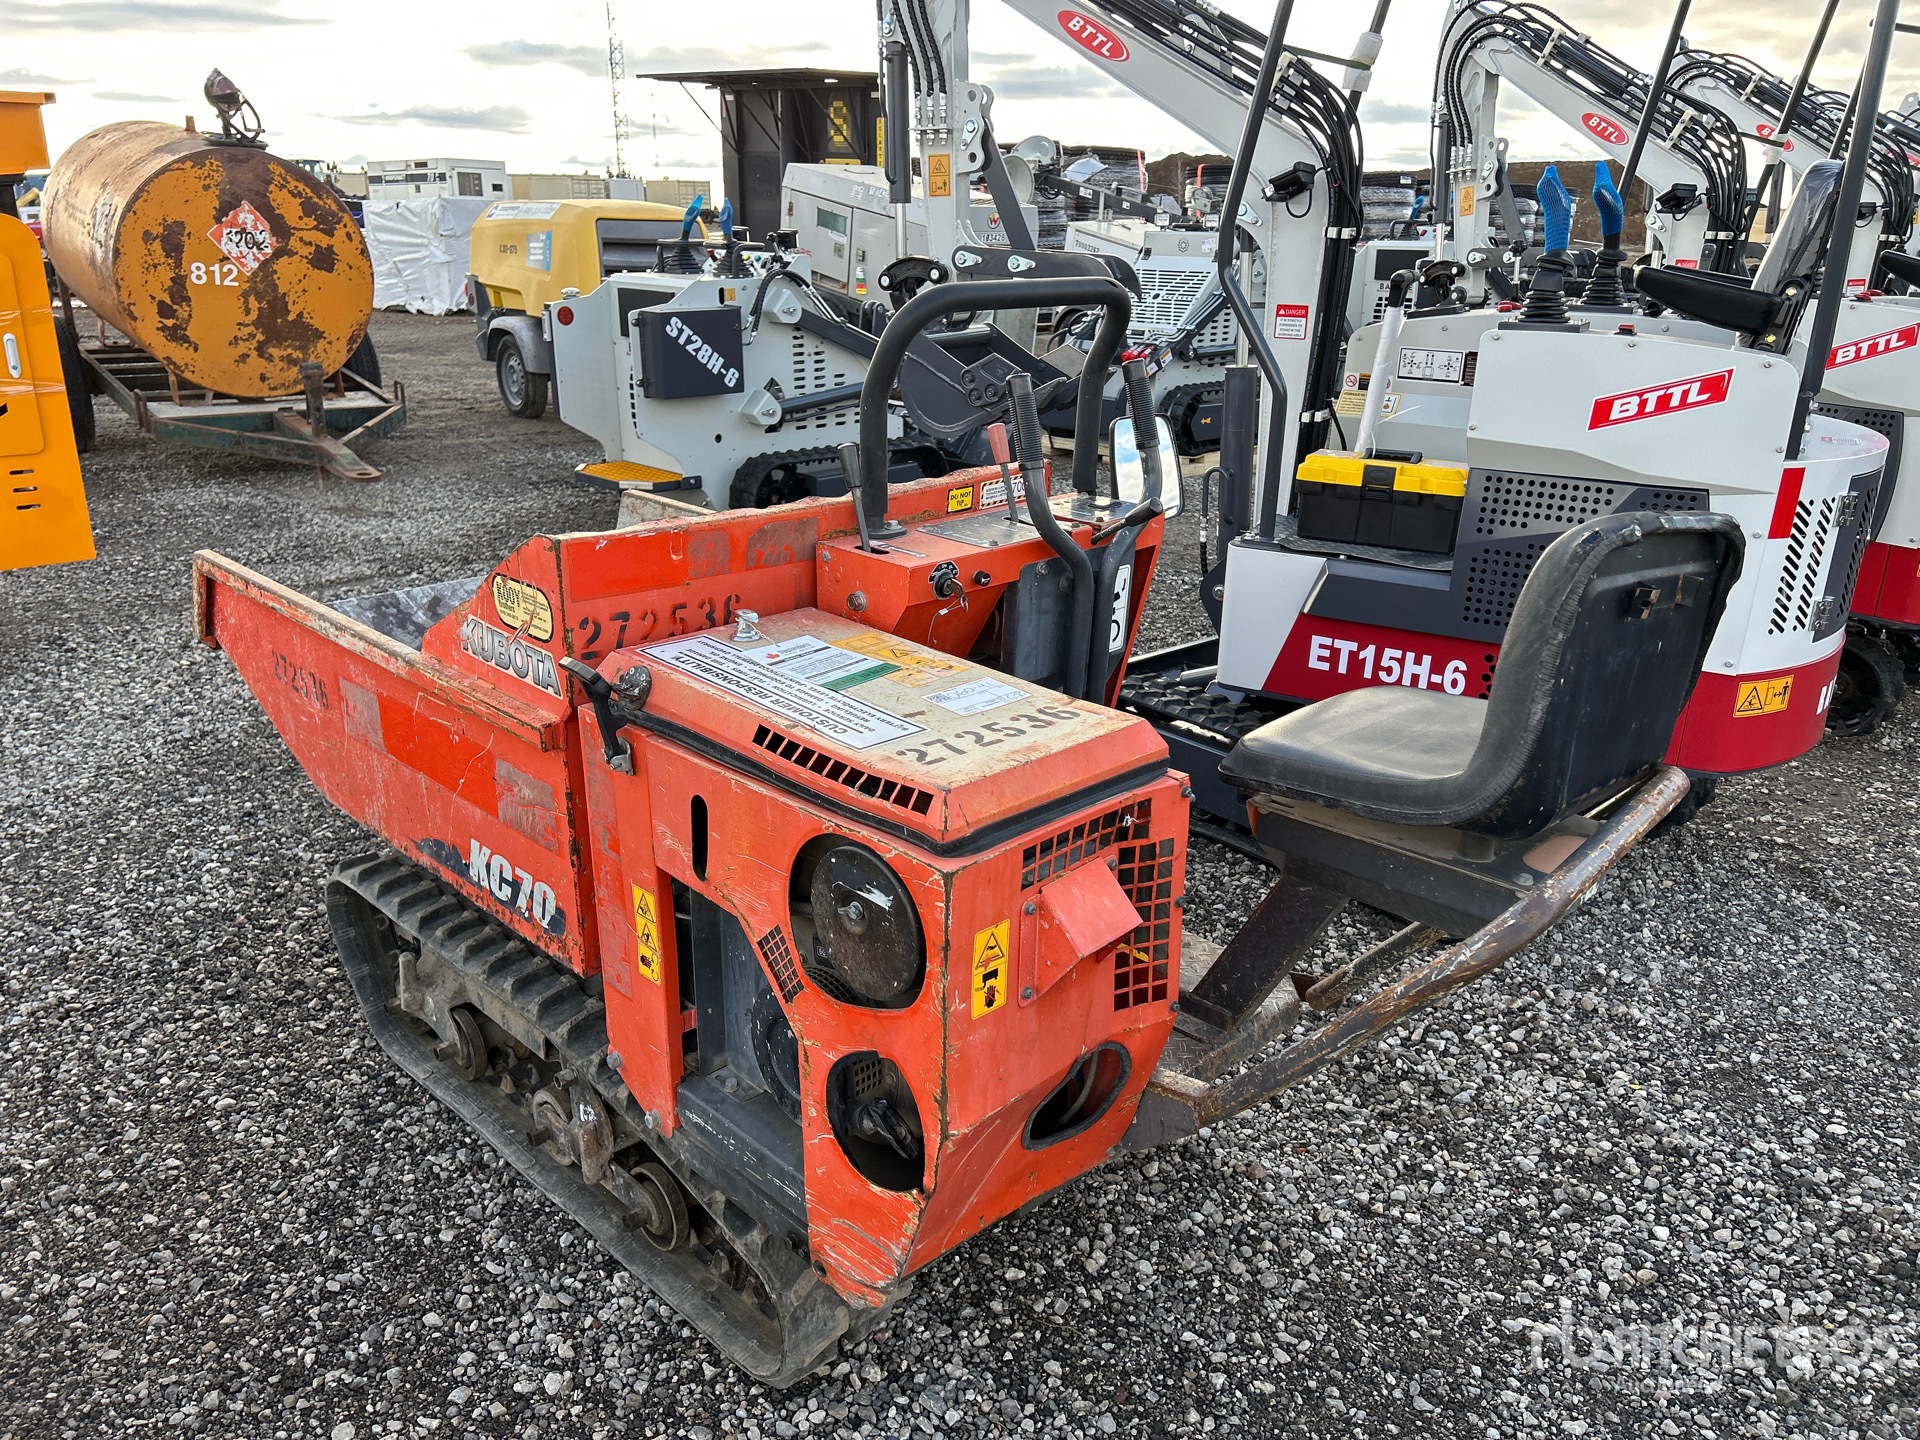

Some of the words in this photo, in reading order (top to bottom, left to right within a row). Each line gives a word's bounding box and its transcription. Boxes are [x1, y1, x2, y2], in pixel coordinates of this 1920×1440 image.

[1067, 16, 1113, 57] BTTL
[1588, 116, 1619, 142] BTTL
[190, 261, 239, 287] 812
[665, 316, 740, 388] ST28H-6
[1835, 333, 1906, 364] BTTL
[1609, 381, 1711, 421] BTTL
[463, 617, 562, 697] KUBOTA
[668, 654, 775, 699] RESPONSIBILITY
[1308, 635, 1467, 695] ET15H-6
[271, 648, 330, 710] 272536
[765, 697, 852, 735] CUSTOMER
[820, 708, 856, 723] SERVICE
[896, 705, 1081, 765] 272536
[469, 838, 557, 929] KC70
